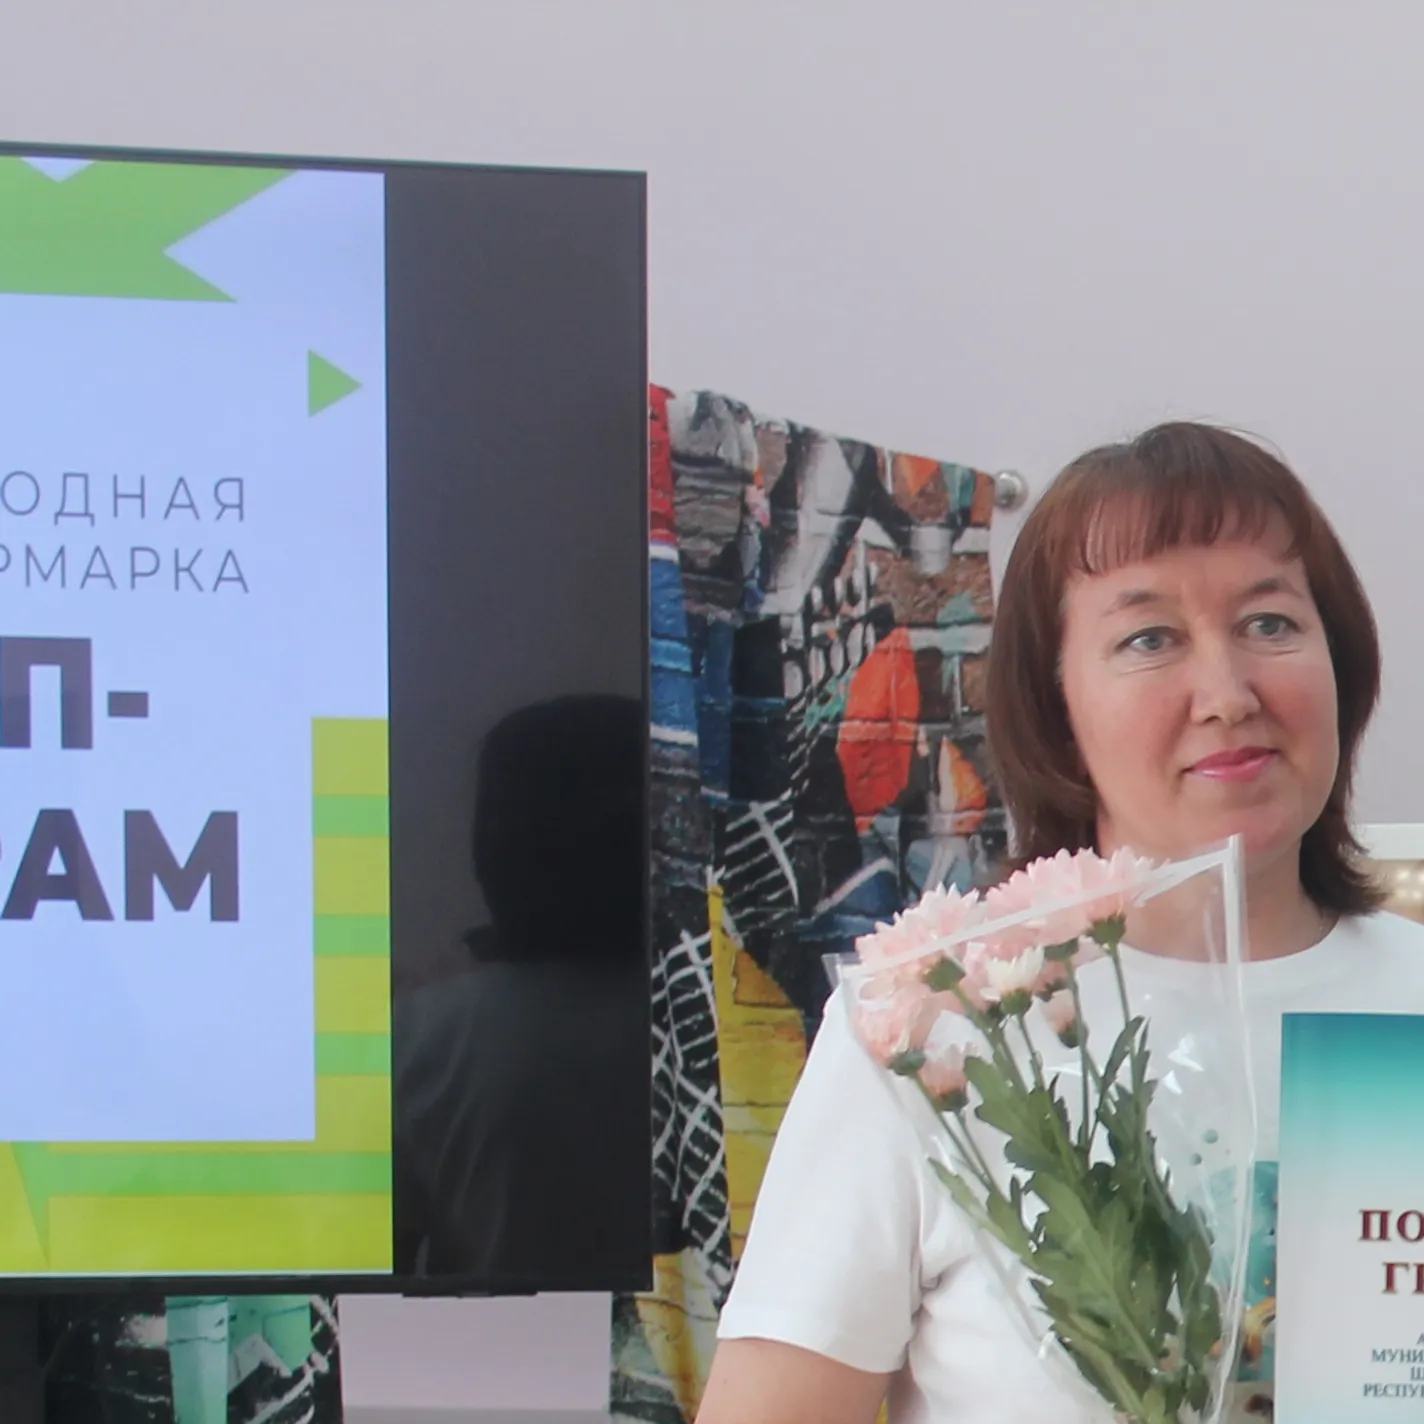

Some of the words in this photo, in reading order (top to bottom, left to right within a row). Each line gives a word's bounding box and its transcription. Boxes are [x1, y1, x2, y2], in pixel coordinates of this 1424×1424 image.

[0, 470, 245, 528] ОДНАЯ
[0, 635, 149, 750] П-
[0, 808, 240, 923] АМ
